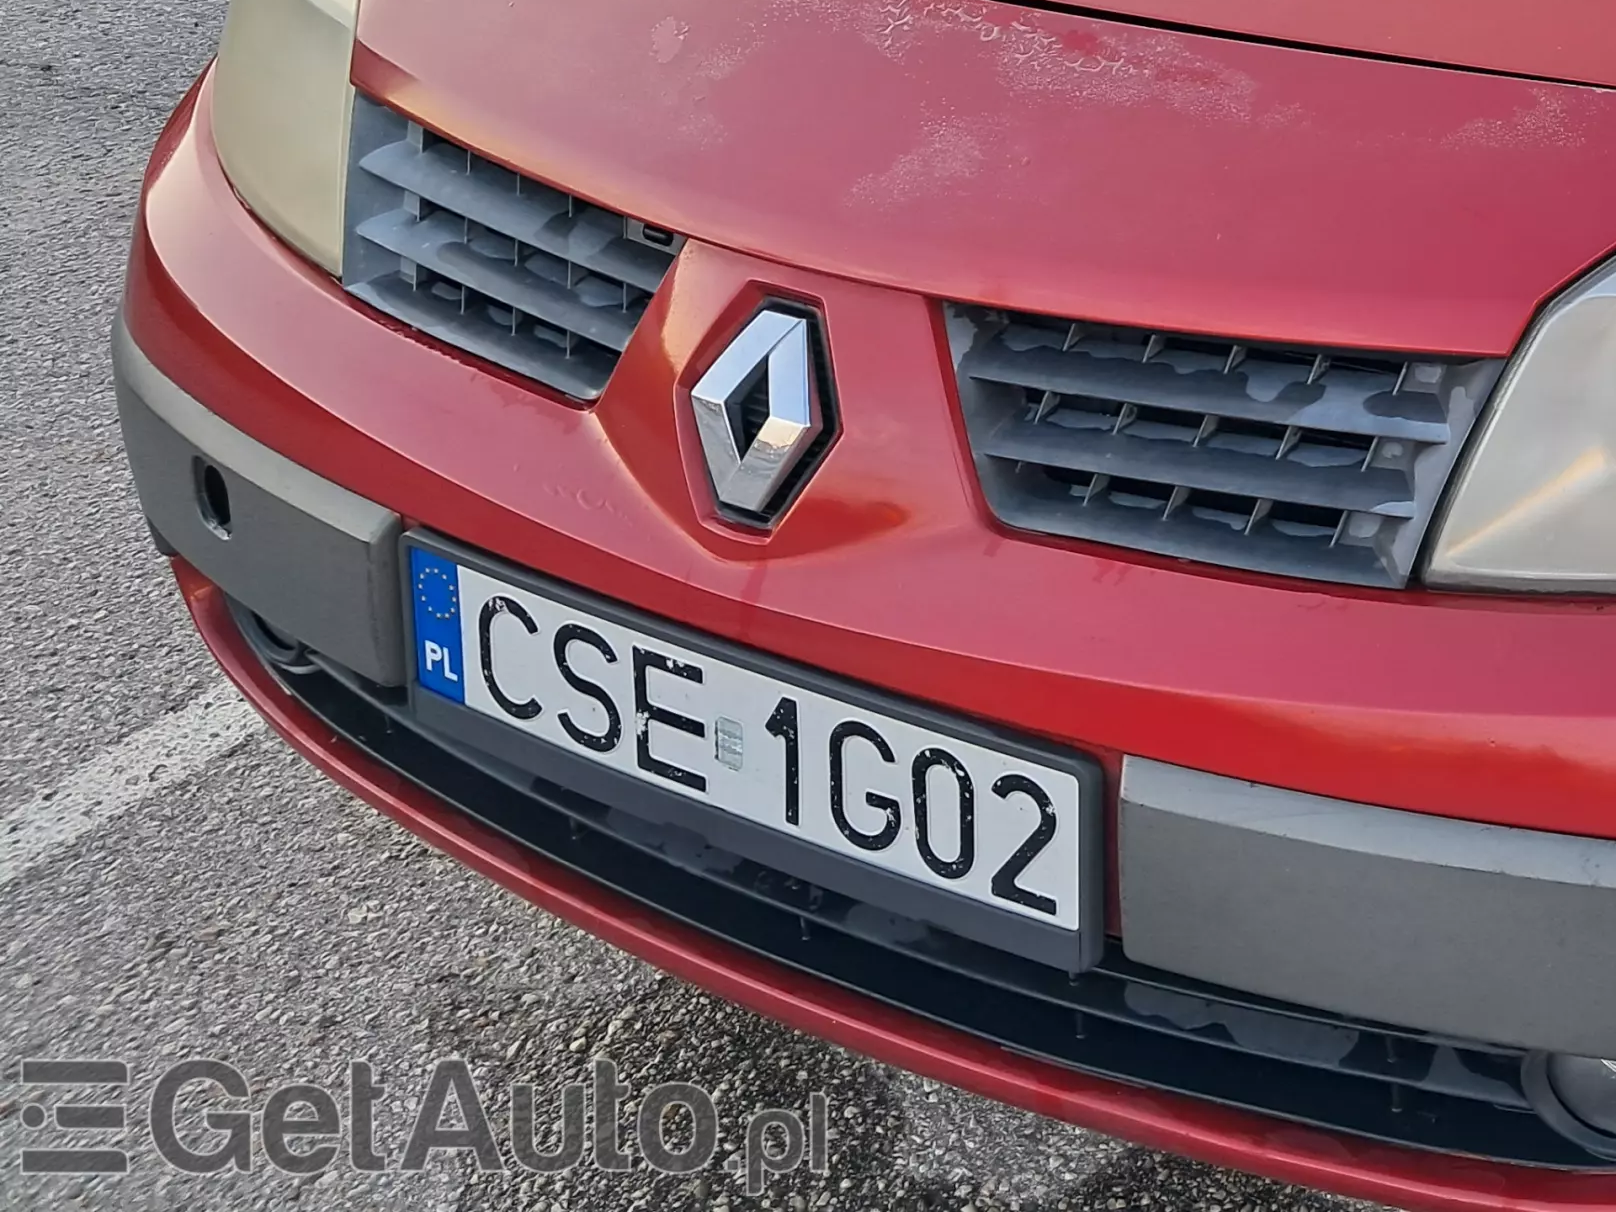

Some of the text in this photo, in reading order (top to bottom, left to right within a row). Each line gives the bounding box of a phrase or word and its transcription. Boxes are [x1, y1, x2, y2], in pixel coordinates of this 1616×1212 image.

[424, 642, 459, 683] PL
[477, 594, 1058, 918] CSE 1G02
